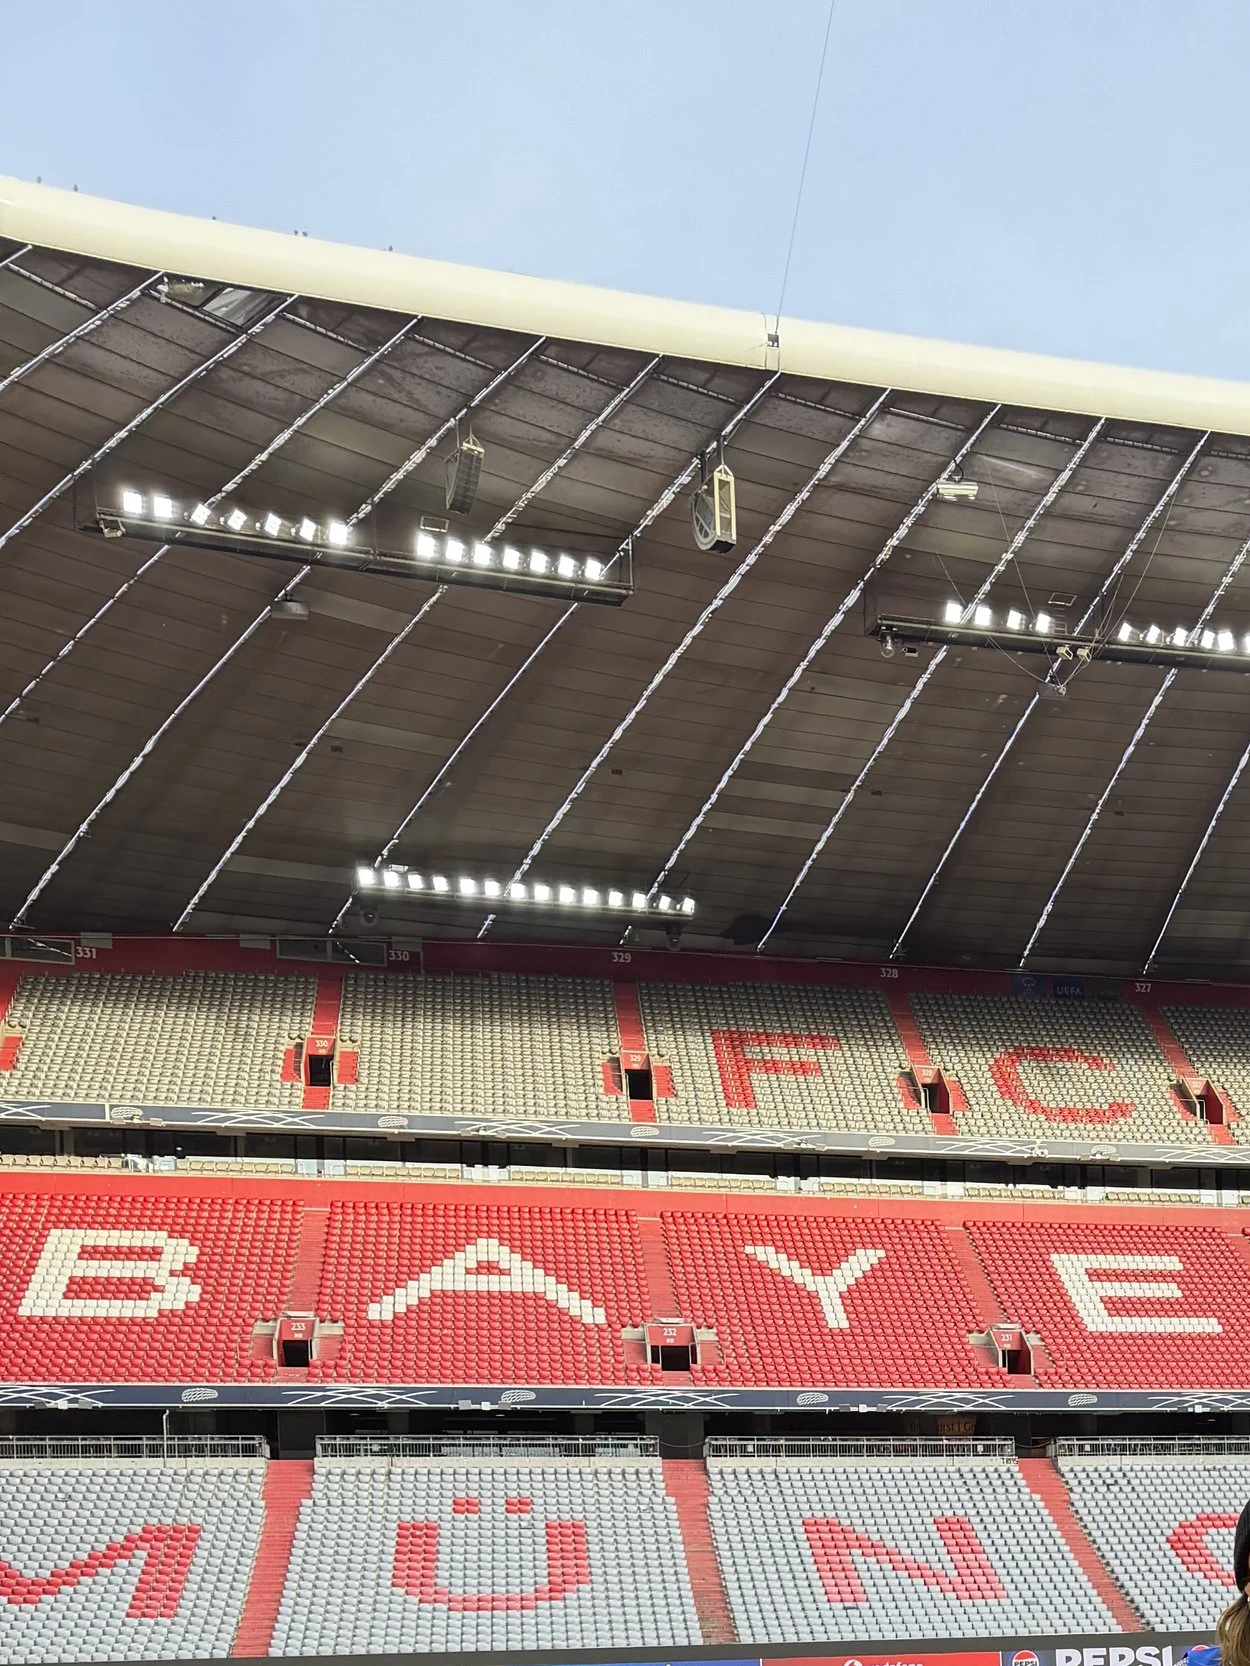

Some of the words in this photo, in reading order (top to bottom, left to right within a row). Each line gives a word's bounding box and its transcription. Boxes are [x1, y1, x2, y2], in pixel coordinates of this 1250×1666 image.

[75, 946, 97, 959] 331
[388, 950, 410, 961] 330
[611, 951, 632, 963] 329
[880, 967, 899, 979] 328
[1134, 982, 1152, 993] 327
[290, 1322, 306, 1331] 233
[663, 1327, 677, 1336] 232
[1001, 1333, 1013, 1342] 231
